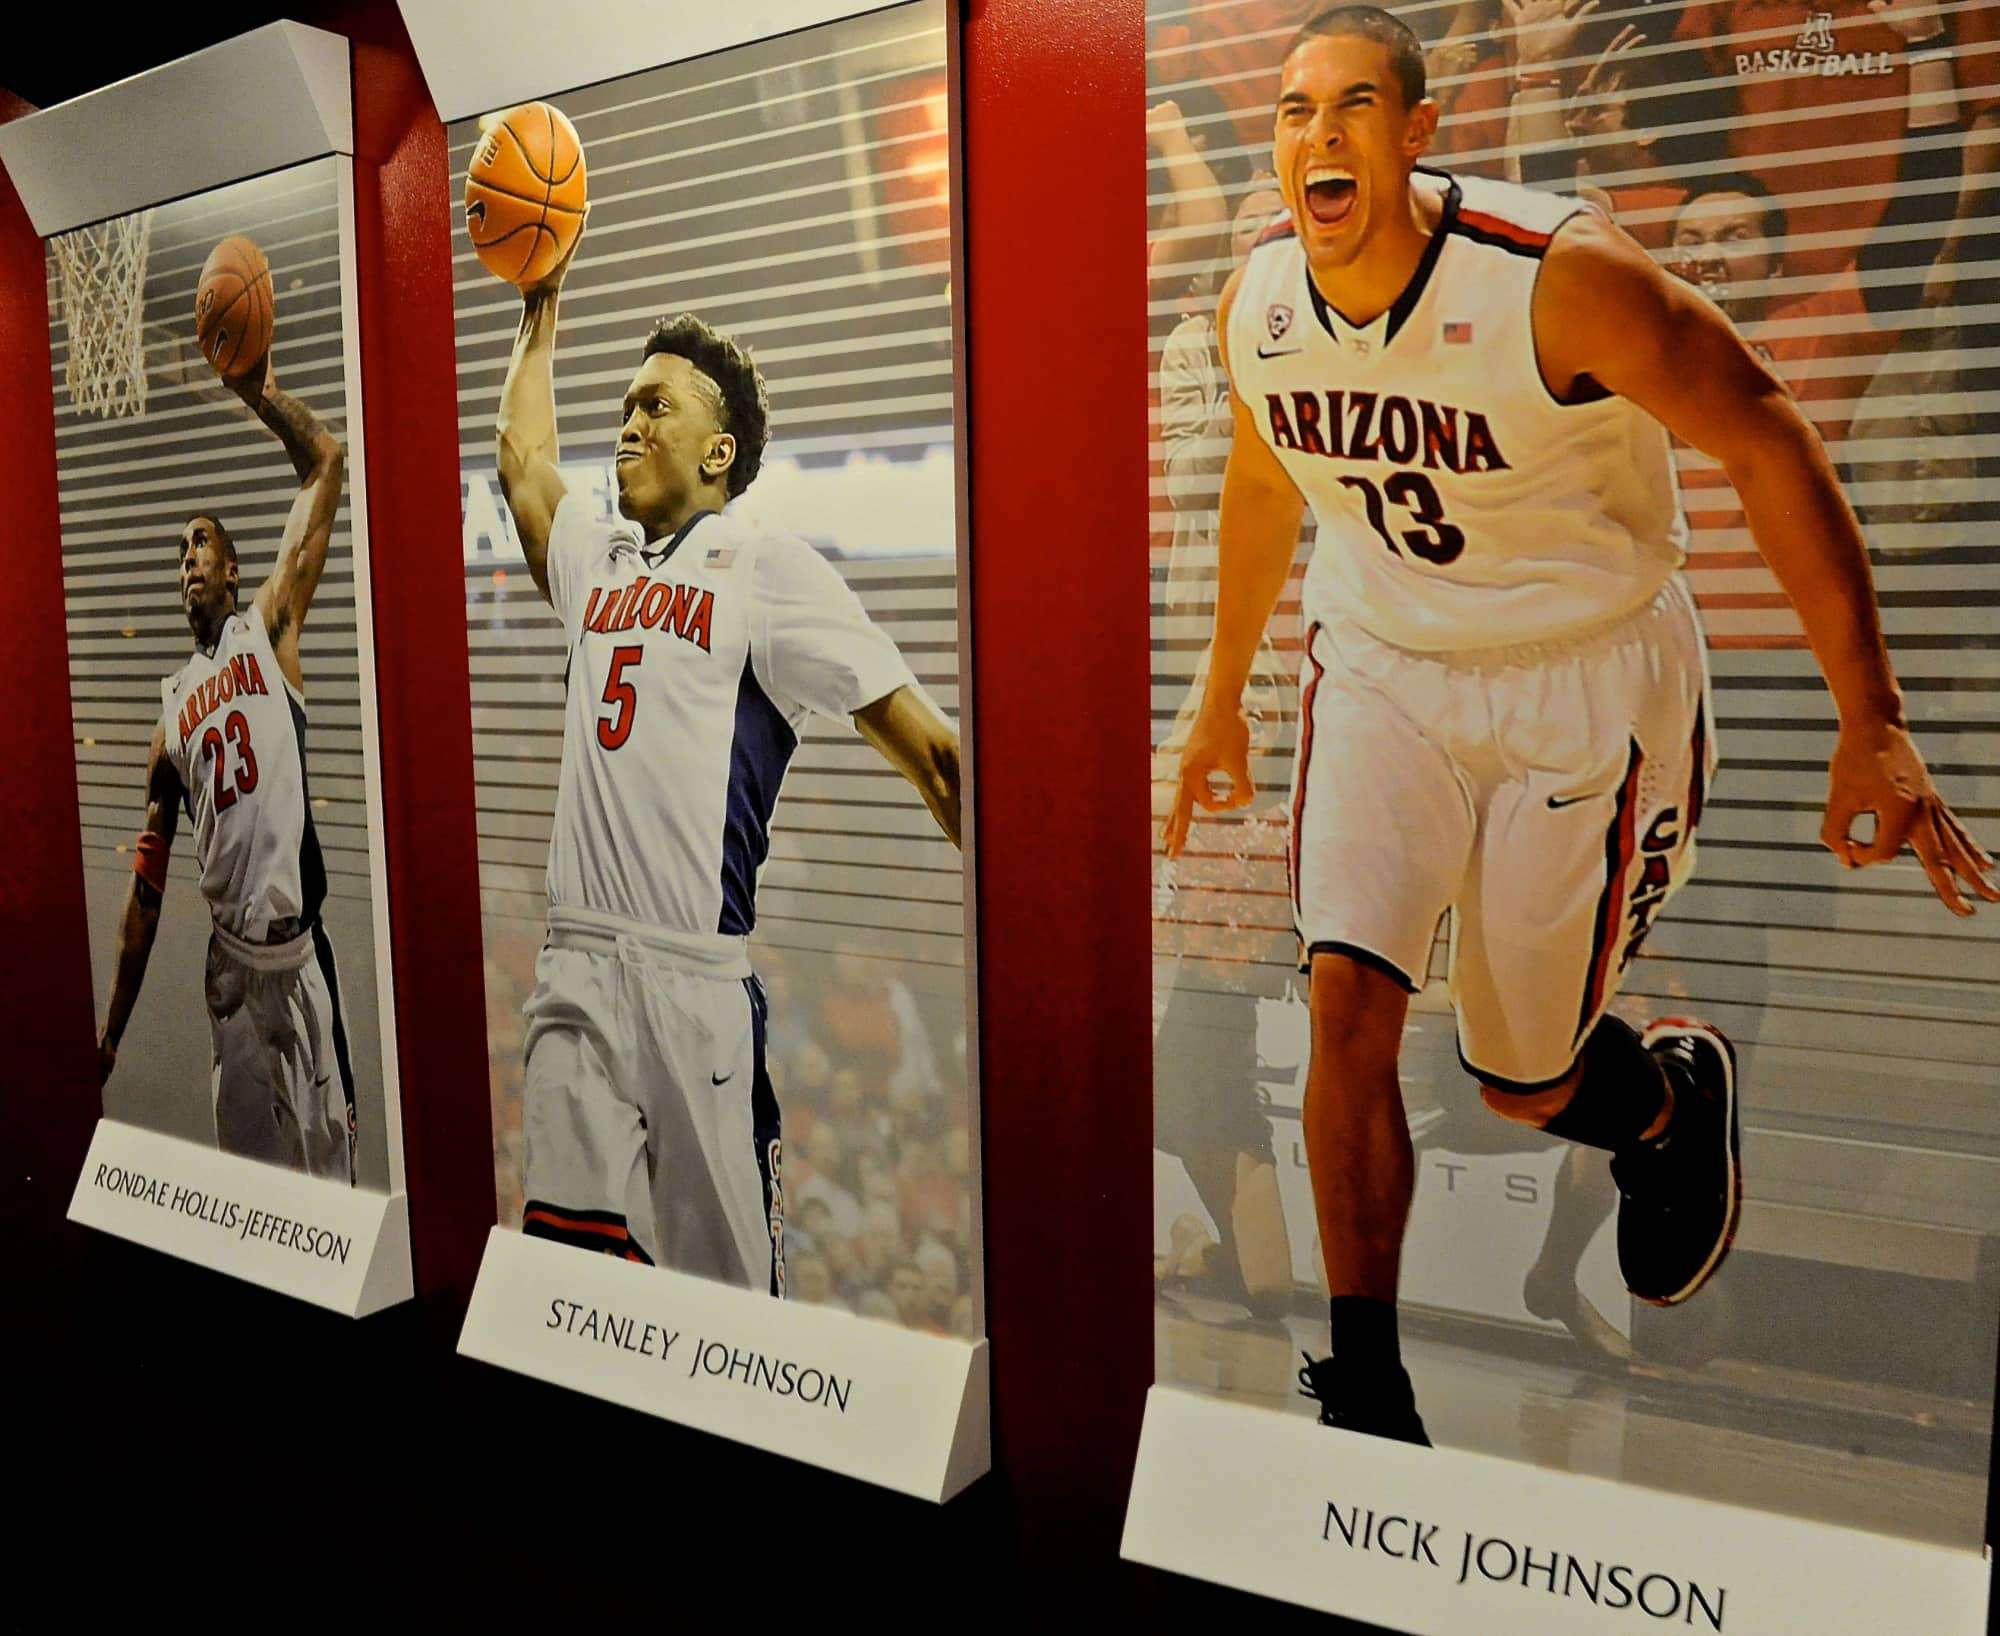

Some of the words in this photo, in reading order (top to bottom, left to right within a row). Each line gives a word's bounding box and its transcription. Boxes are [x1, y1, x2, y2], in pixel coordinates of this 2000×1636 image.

[1735, 50, 1893, 77] BASKETBALL
[1265, 390, 1513, 474] ARIZONA
[1336, 471, 1465, 566] 13
[178, 653, 269, 754] ARIZONA
[597, 644, 644, 751] 5
[202, 710, 259, 815] 23
[94, 1163, 169, 1207] RONDAE
[170, 1185, 351, 1265] HOLLIS-JEFFERSON
[546, 1299, 680, 1361] STANLEY
[688, 1338, 852, 1413] JOHNSON
[1322, 1501, 1440, 1567] NICK
[1457, 1532, 1727, 1632] JOHNSON
